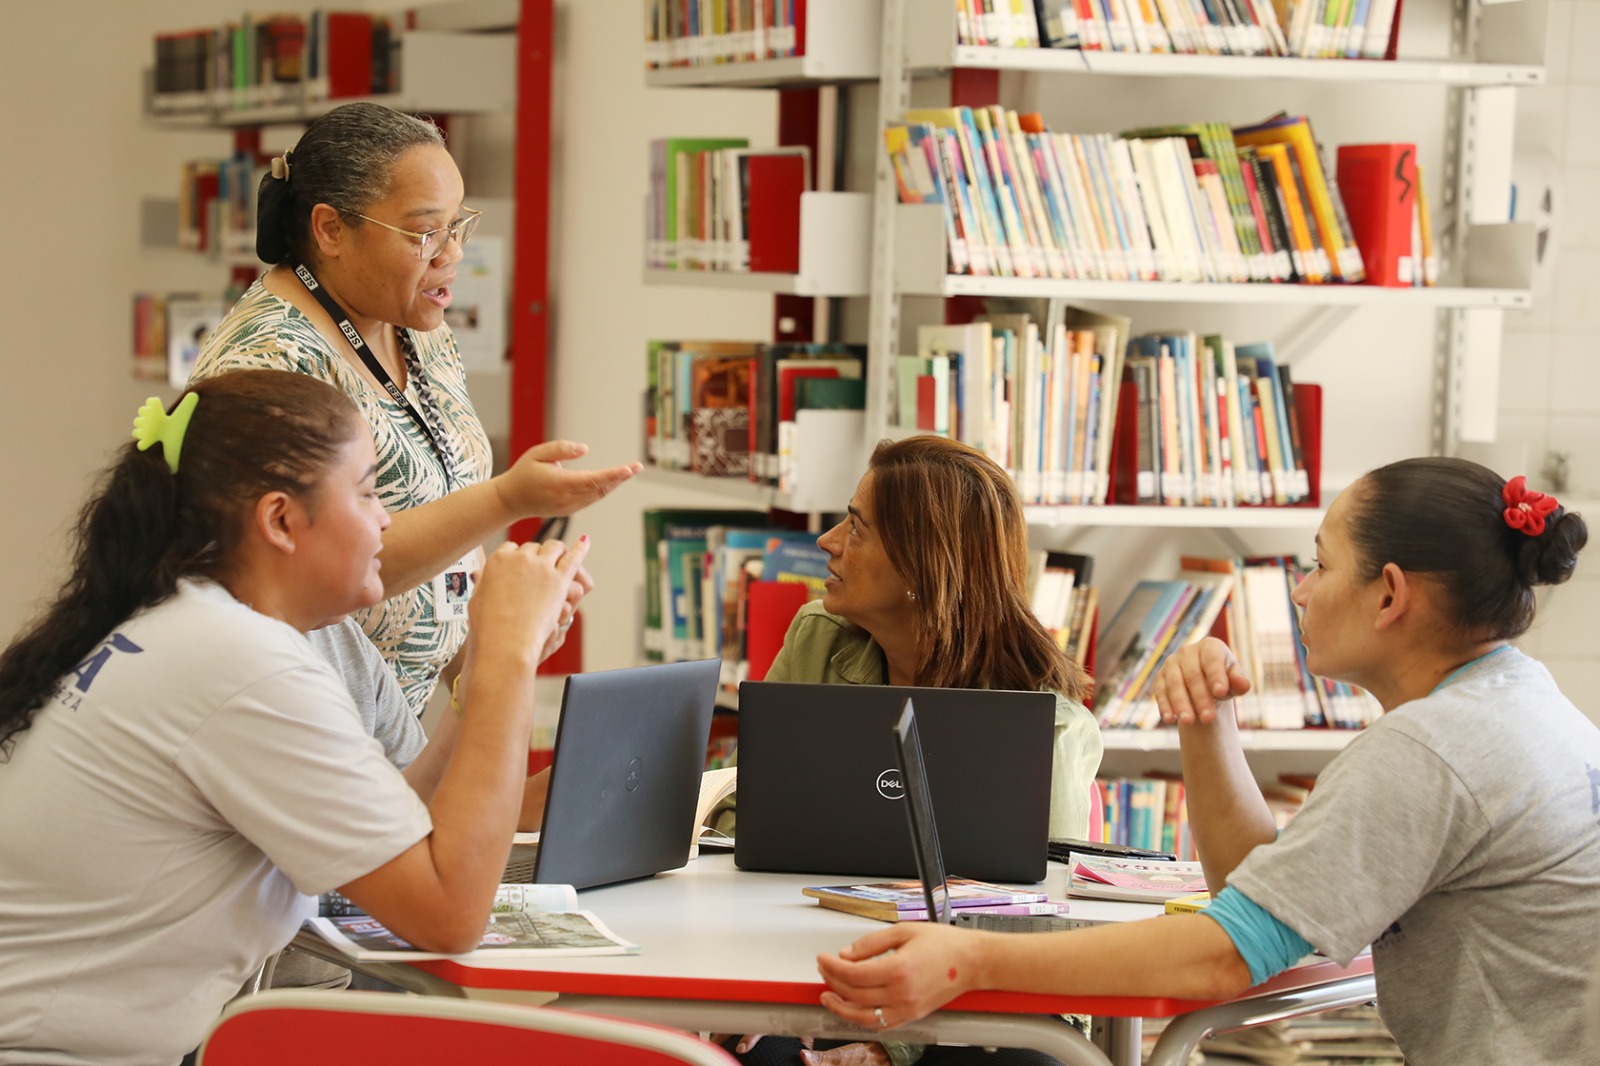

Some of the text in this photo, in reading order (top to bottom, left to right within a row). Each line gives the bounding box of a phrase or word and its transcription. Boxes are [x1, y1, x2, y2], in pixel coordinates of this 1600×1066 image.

[296, 267, 316, 287] SESI
[342, 323, 361, 346] SESI
[387, 384, 406, 404] SESI
[881, 779, 904, 789] DEL
